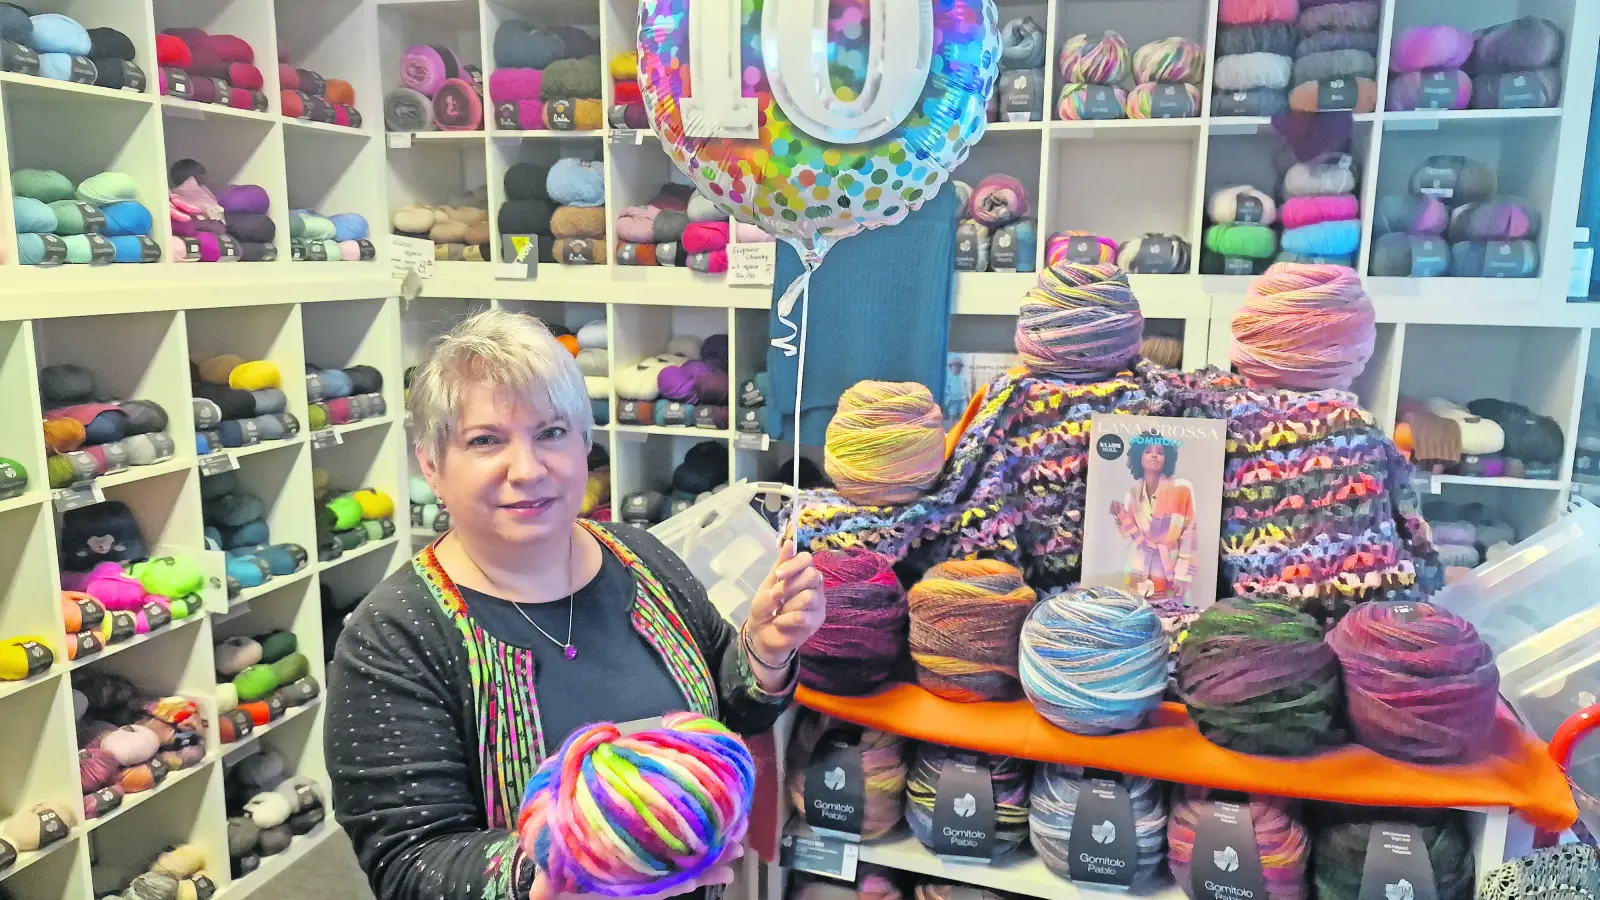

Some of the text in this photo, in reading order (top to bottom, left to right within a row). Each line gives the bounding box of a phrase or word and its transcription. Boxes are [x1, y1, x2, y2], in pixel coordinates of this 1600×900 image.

[679, 0, 934, 144] 10
[1098, 421, 1219, 440] LANA GROSSA
[814, 799, 855, 814] Gomitolo
[821, 808, 848, 822] Pablo
[943, 826, 986, 839] Gomitolo
[950, 836, 978, 847] Pablo
[1080, 853, 1126, 868] Gomitolo
[1088, 863, 1117, 876] Pablo
[1204, 880, 1254, 898] Gomitolo
